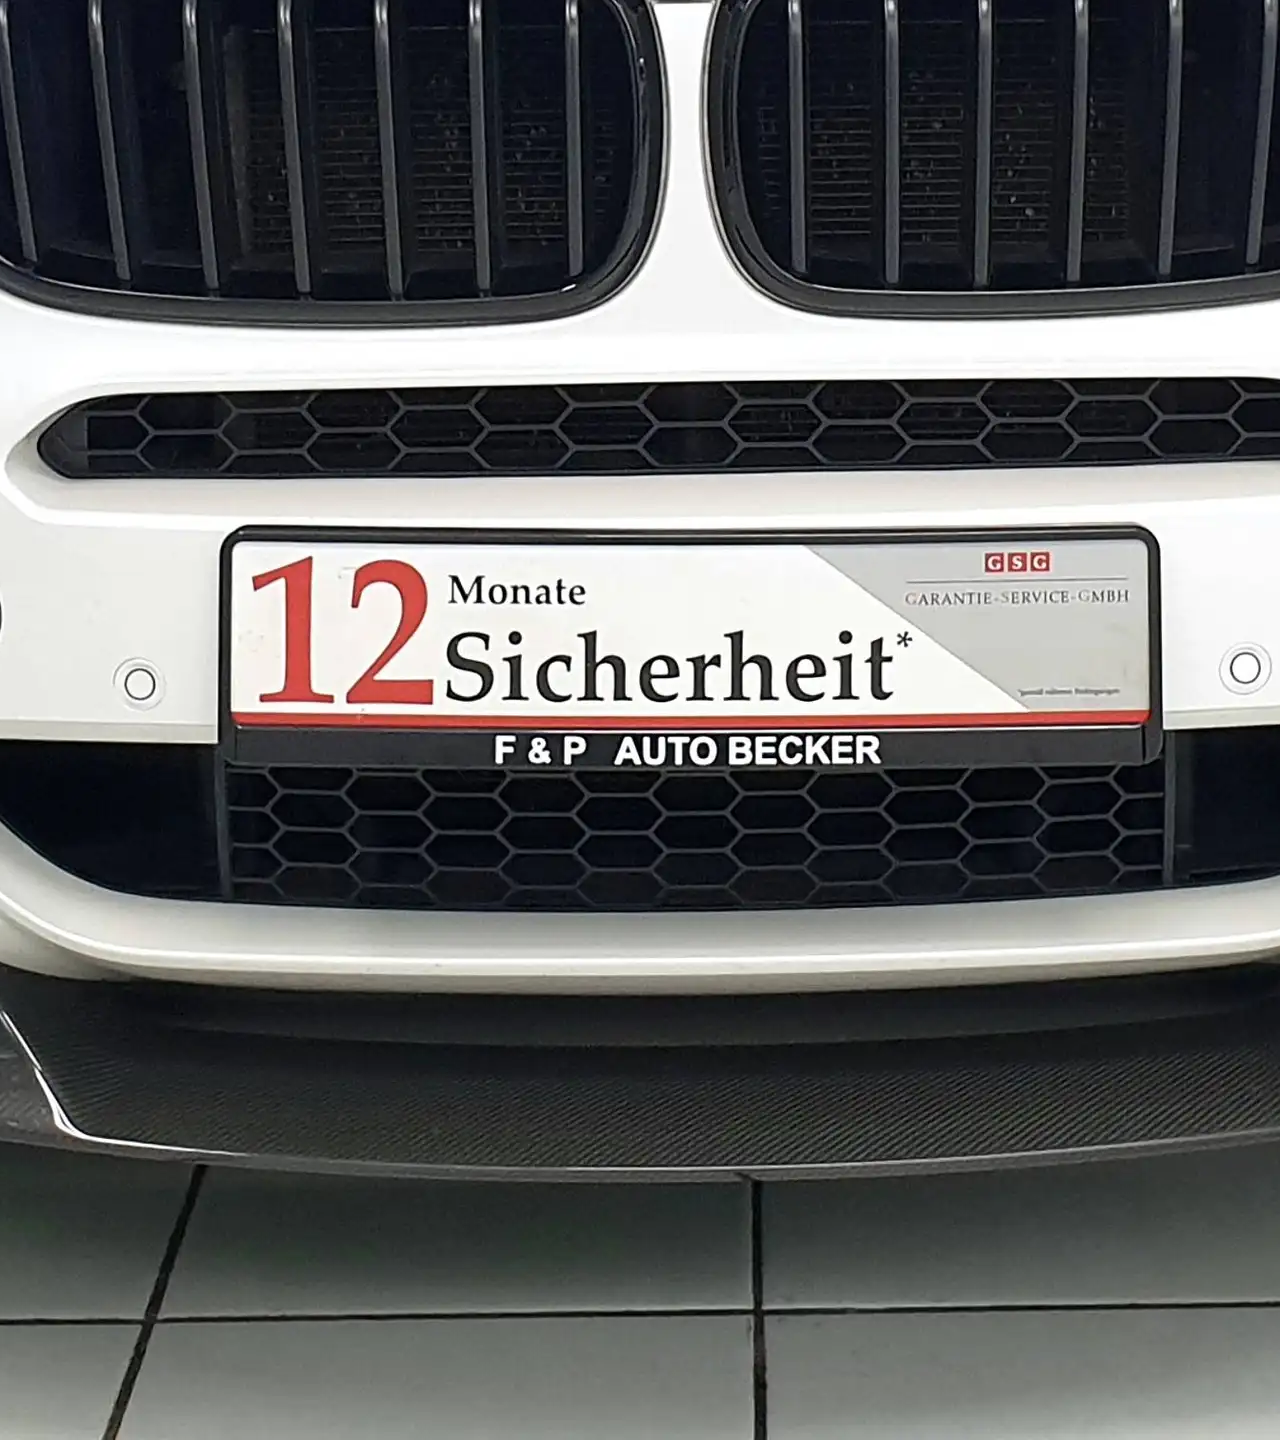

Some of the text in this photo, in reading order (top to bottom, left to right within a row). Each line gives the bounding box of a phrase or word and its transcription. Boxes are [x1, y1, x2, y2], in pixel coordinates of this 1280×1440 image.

[985, 553, 1051, 573] GSG
[252, 556, 587, 705] 12 Monate
[495, 734, 882, 766] F & P AUTO BECKER
